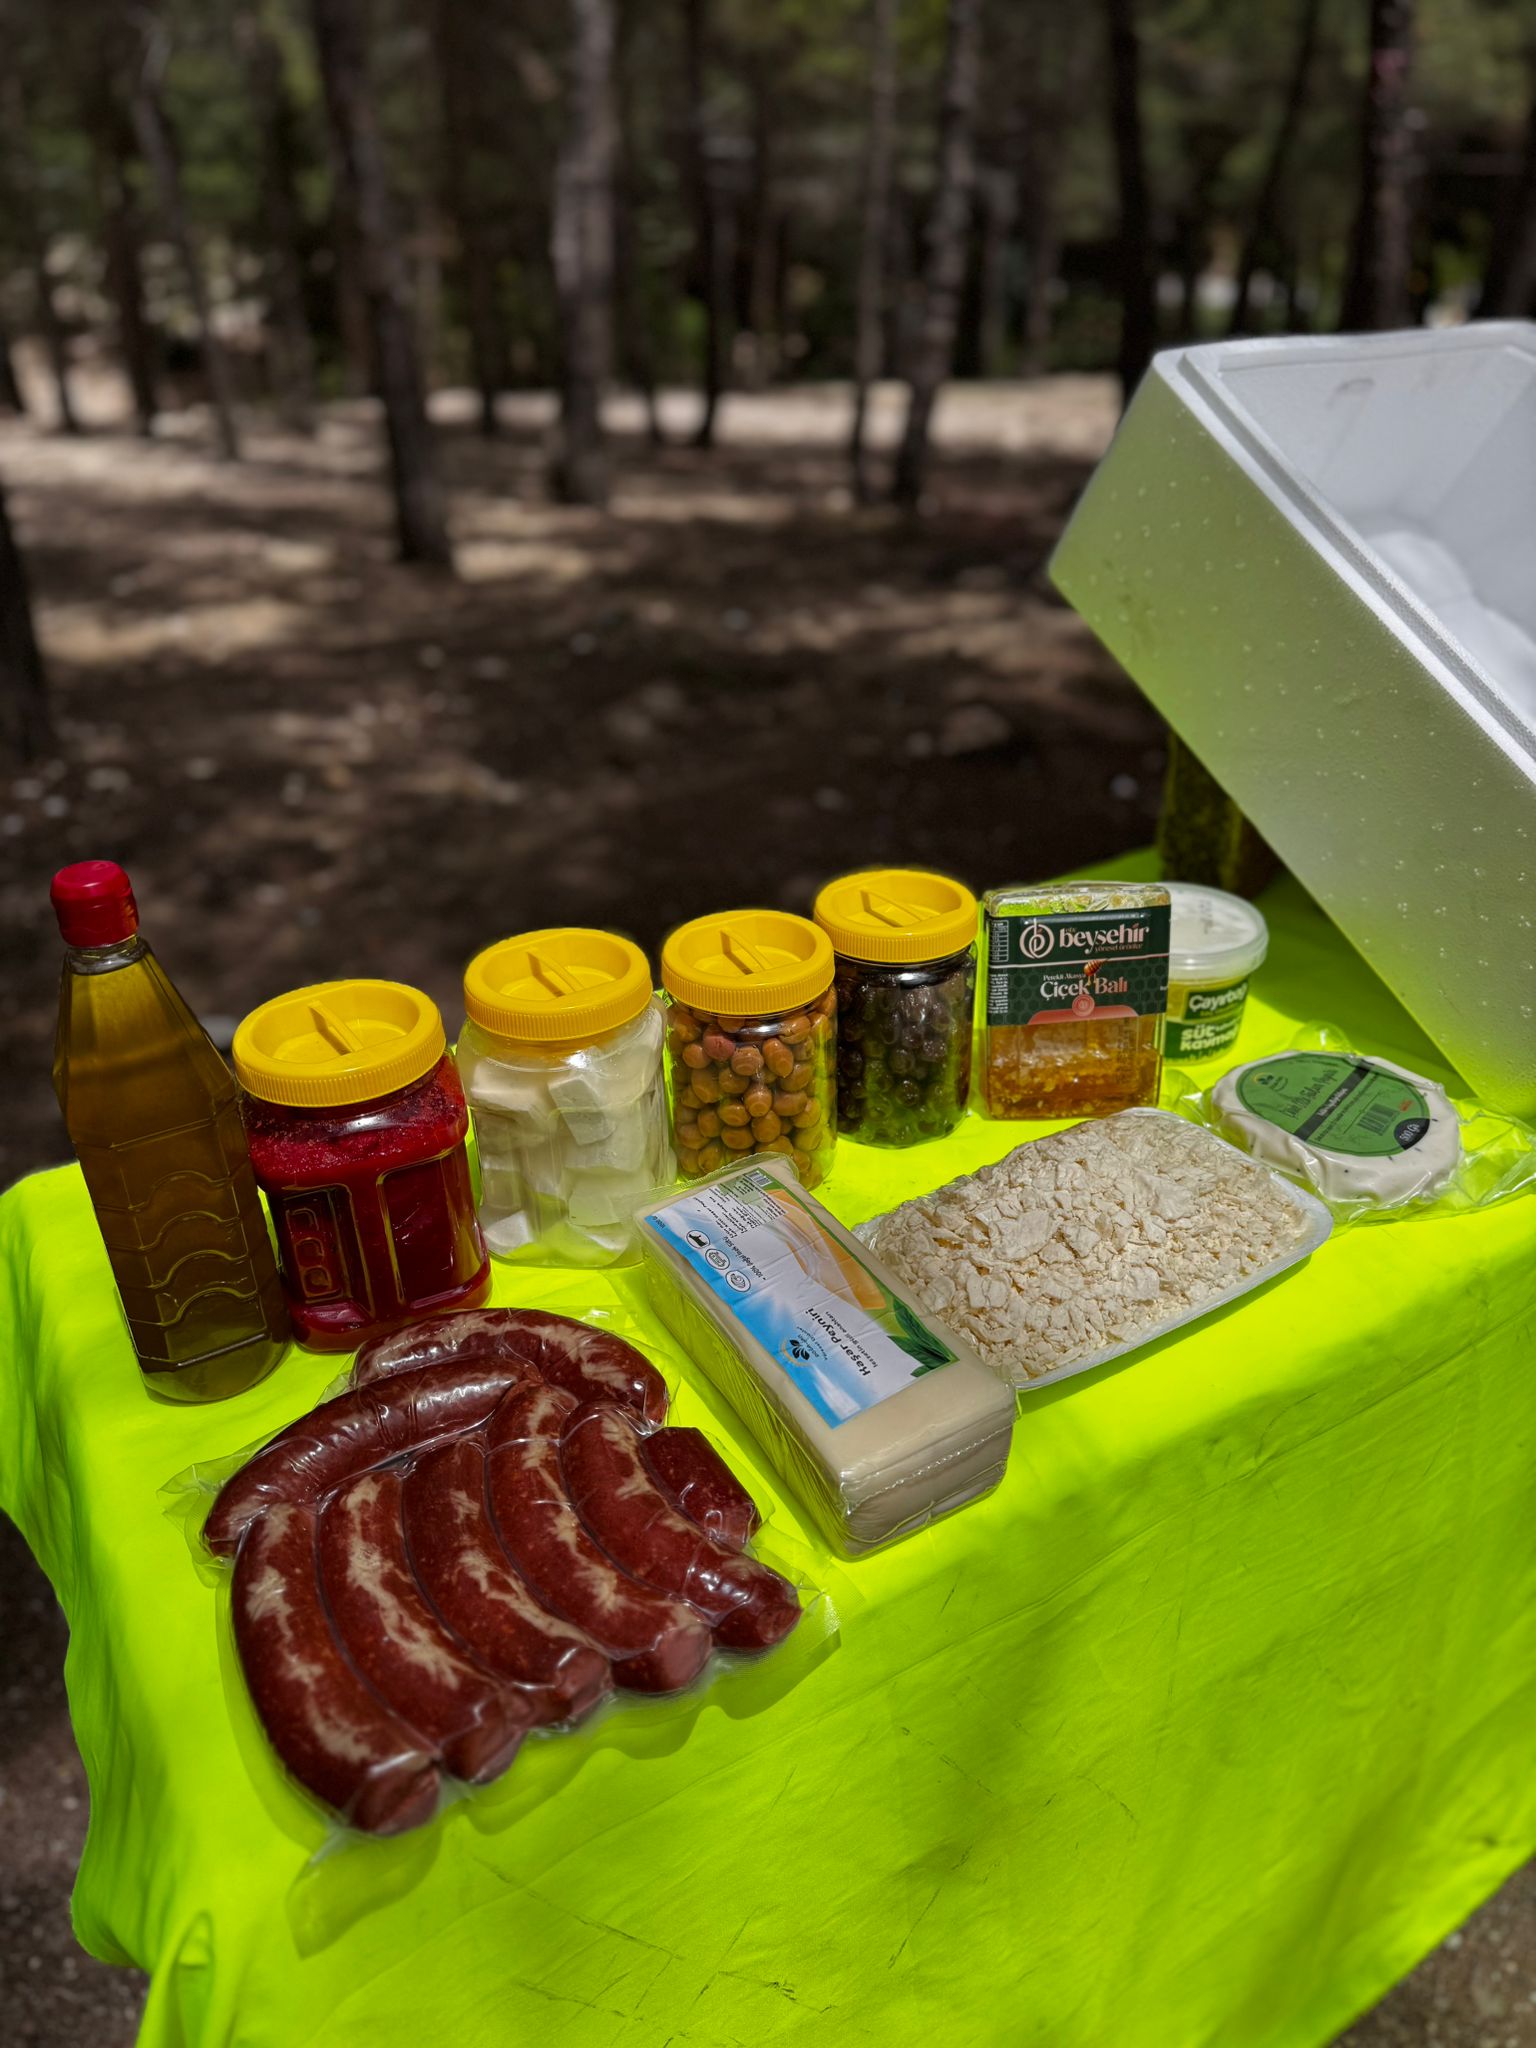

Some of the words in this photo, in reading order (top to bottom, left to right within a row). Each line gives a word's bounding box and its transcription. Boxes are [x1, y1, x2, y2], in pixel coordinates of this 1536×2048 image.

[1040, 980, 1090, 1000] Çiçek
[1094, 977, 1128, 995] Balı
[805, 1307, 843, 1344] Peyniri
